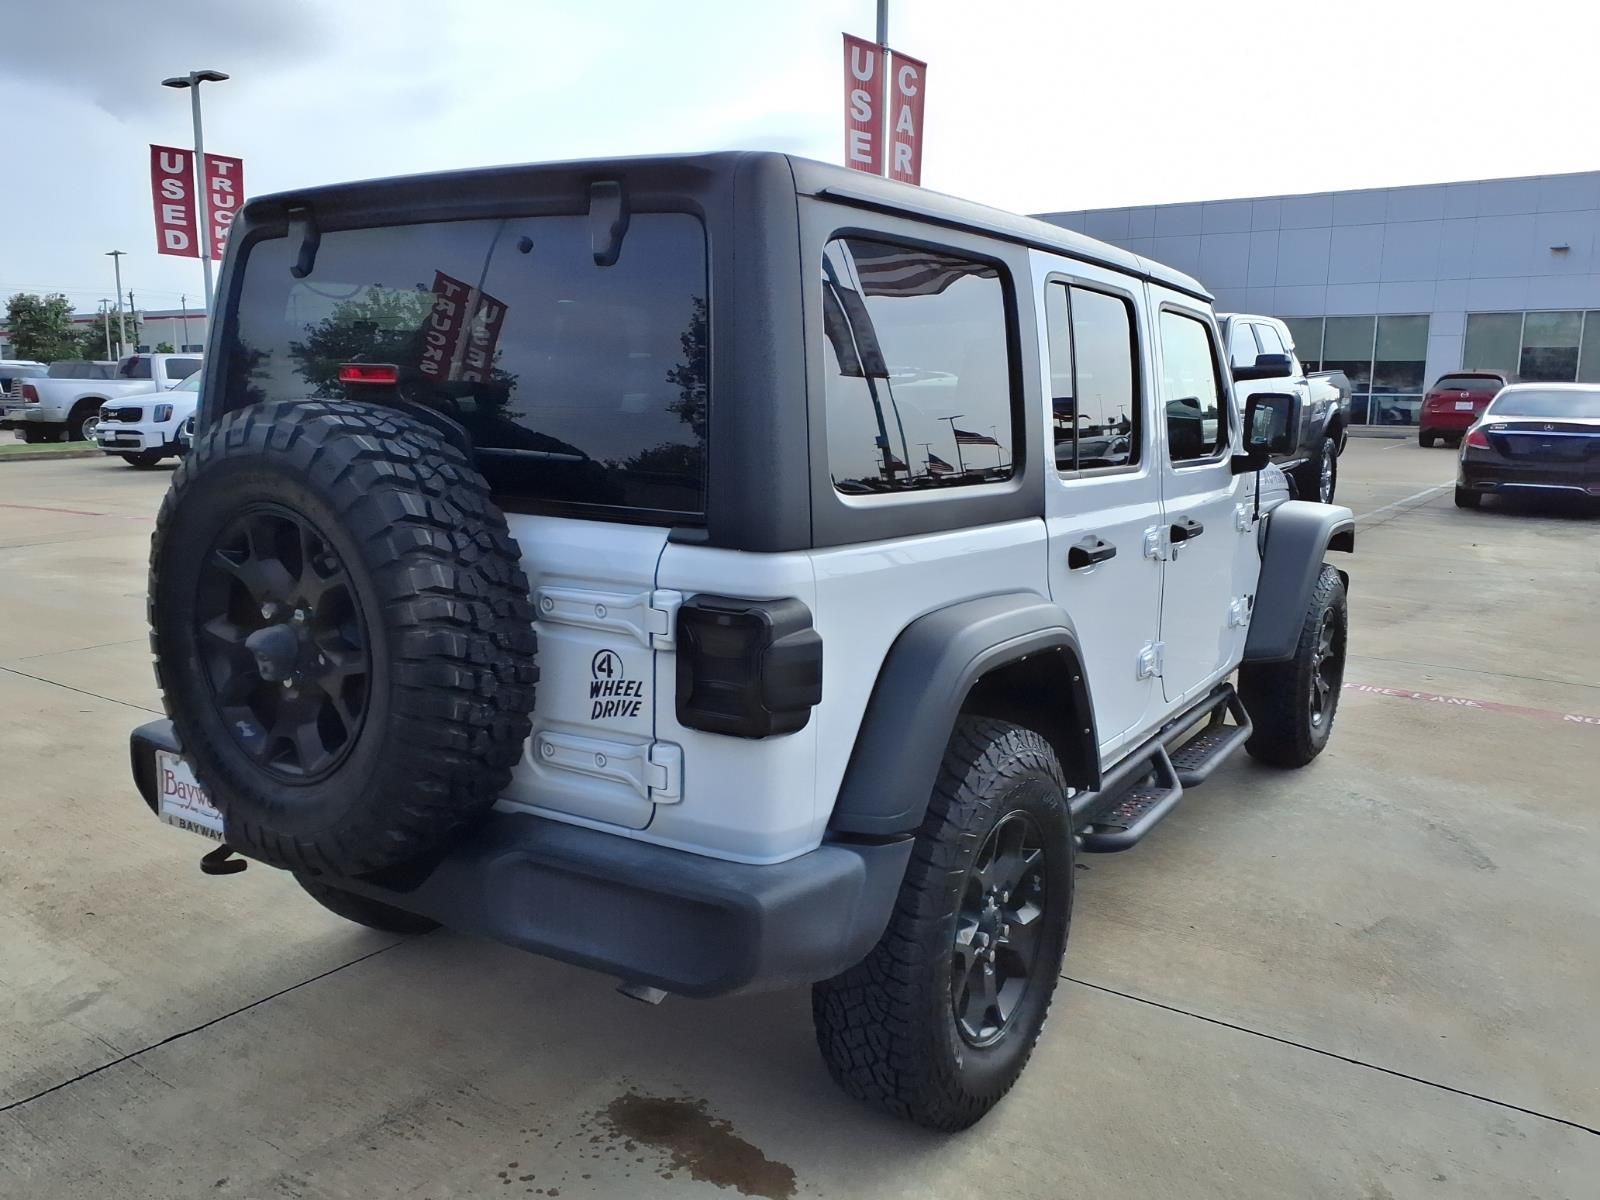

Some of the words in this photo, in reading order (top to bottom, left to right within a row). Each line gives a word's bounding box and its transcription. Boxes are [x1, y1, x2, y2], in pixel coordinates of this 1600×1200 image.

[850, 46, 874, 164] USE
[894, 65, 918, 175] CAR
[160, 152, 189, 250] USED
[597, 654, 613, 678] 4
[590, 680, 643, 699] WHEEL
[1343, 683, 1398, 696] FIRE
[1411, 692, 1482, 708] LANE
[591, 700, 642, 720] DRIVE
[164, 769, 221, 819] Bayw
[179, 818, 223, 840] BAYWAY
